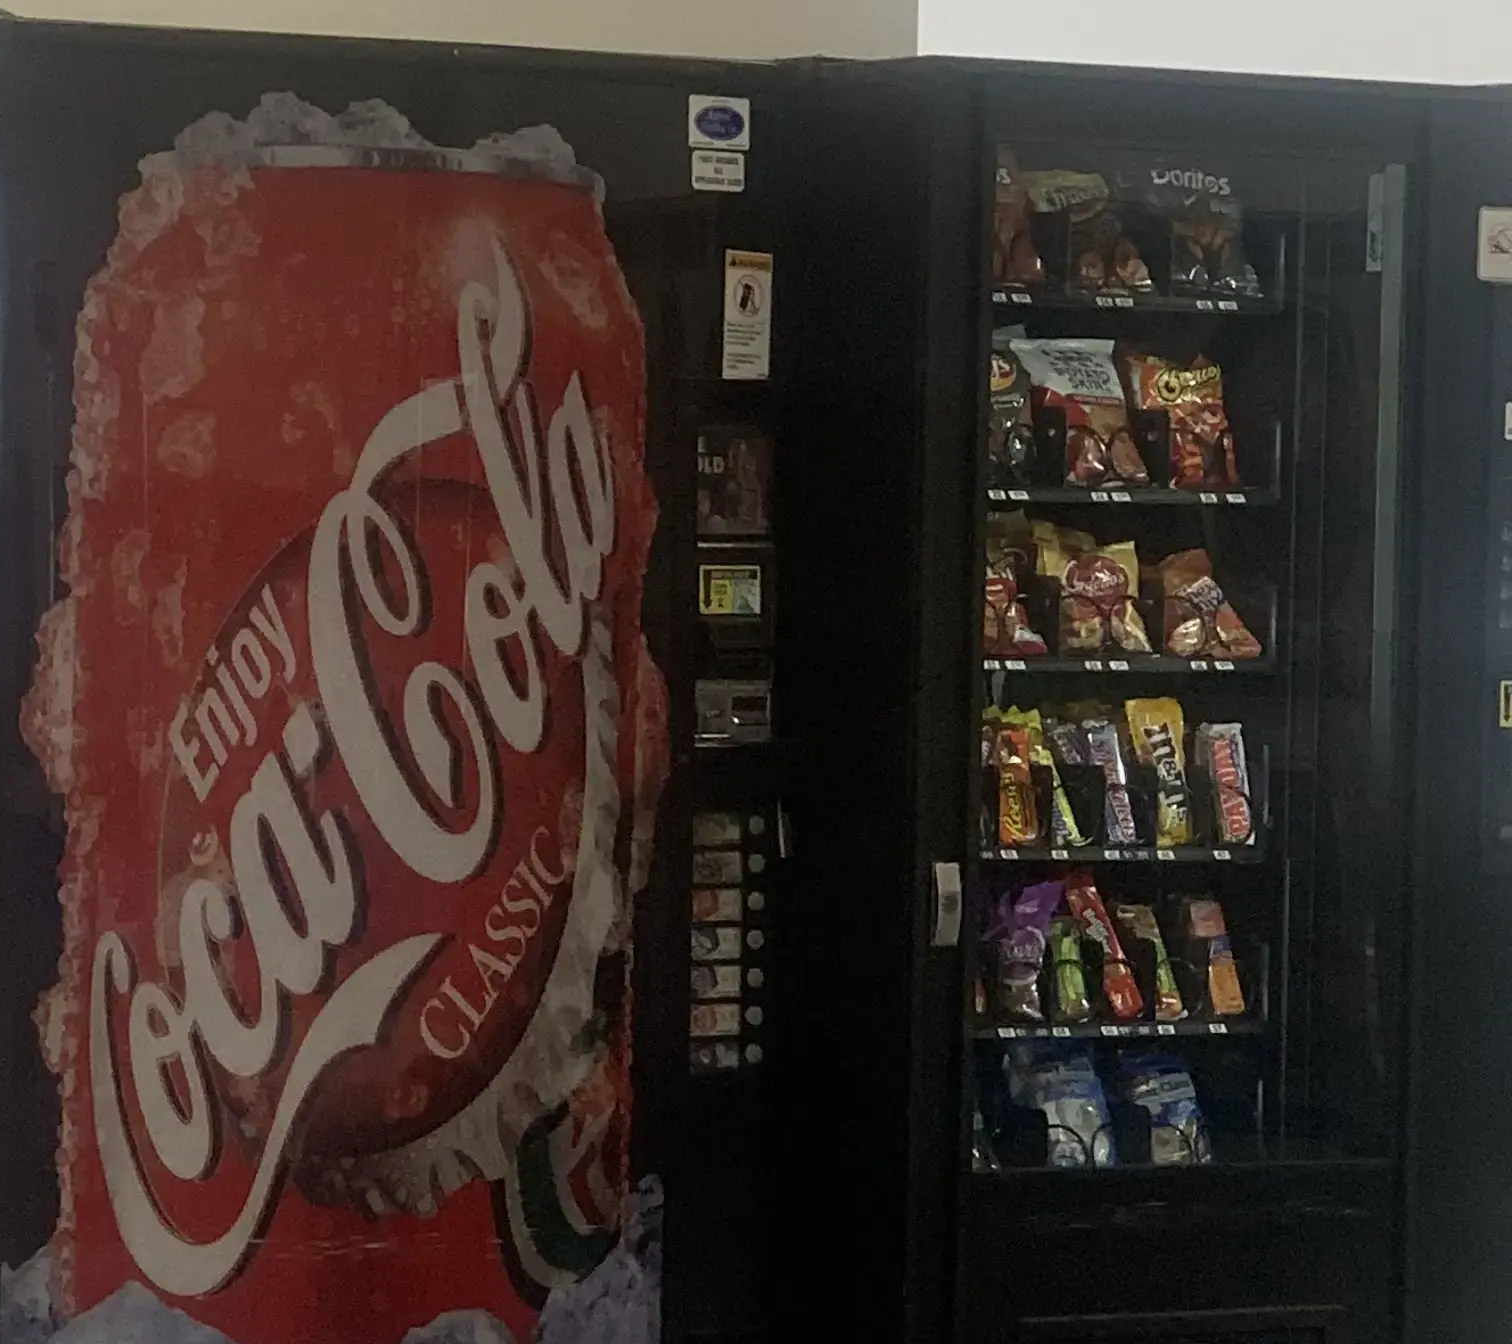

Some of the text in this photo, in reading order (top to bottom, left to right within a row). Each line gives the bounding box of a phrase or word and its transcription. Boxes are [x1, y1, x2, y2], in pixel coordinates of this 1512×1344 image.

[89, 226, 614, 1298] Coca-Cola
[168, 582, 297, 804] Enjoy
[419, 824, 569, 1059] CLASSIC
